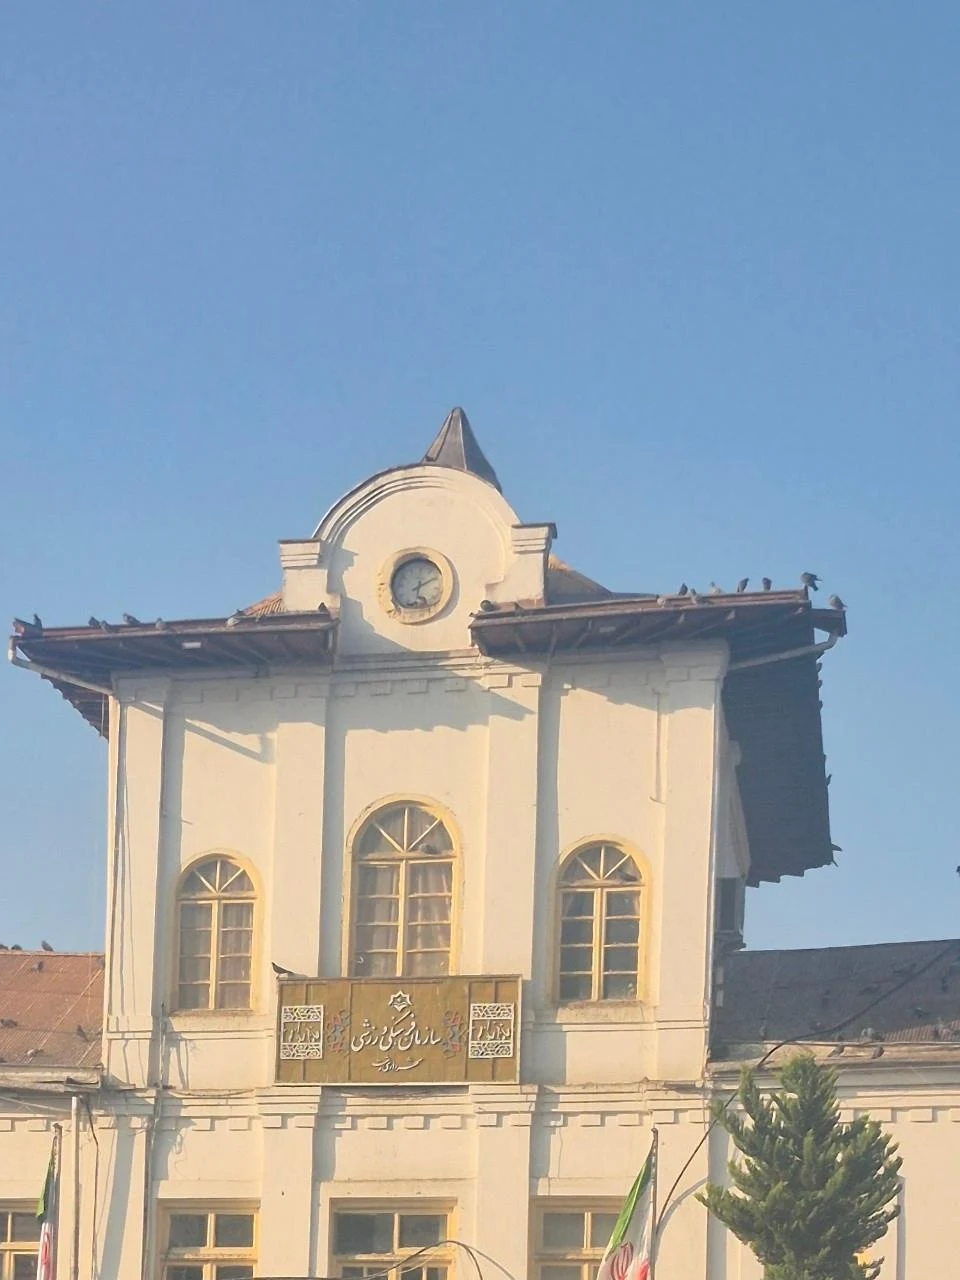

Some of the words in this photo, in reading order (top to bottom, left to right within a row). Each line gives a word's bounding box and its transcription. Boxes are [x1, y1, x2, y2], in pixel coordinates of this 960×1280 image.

[379, 1009, 416, 1051] فرهنگی
[398, 1026, 441, 1051] سازمان
[382, 1056, 424, 1072] شهرداری
